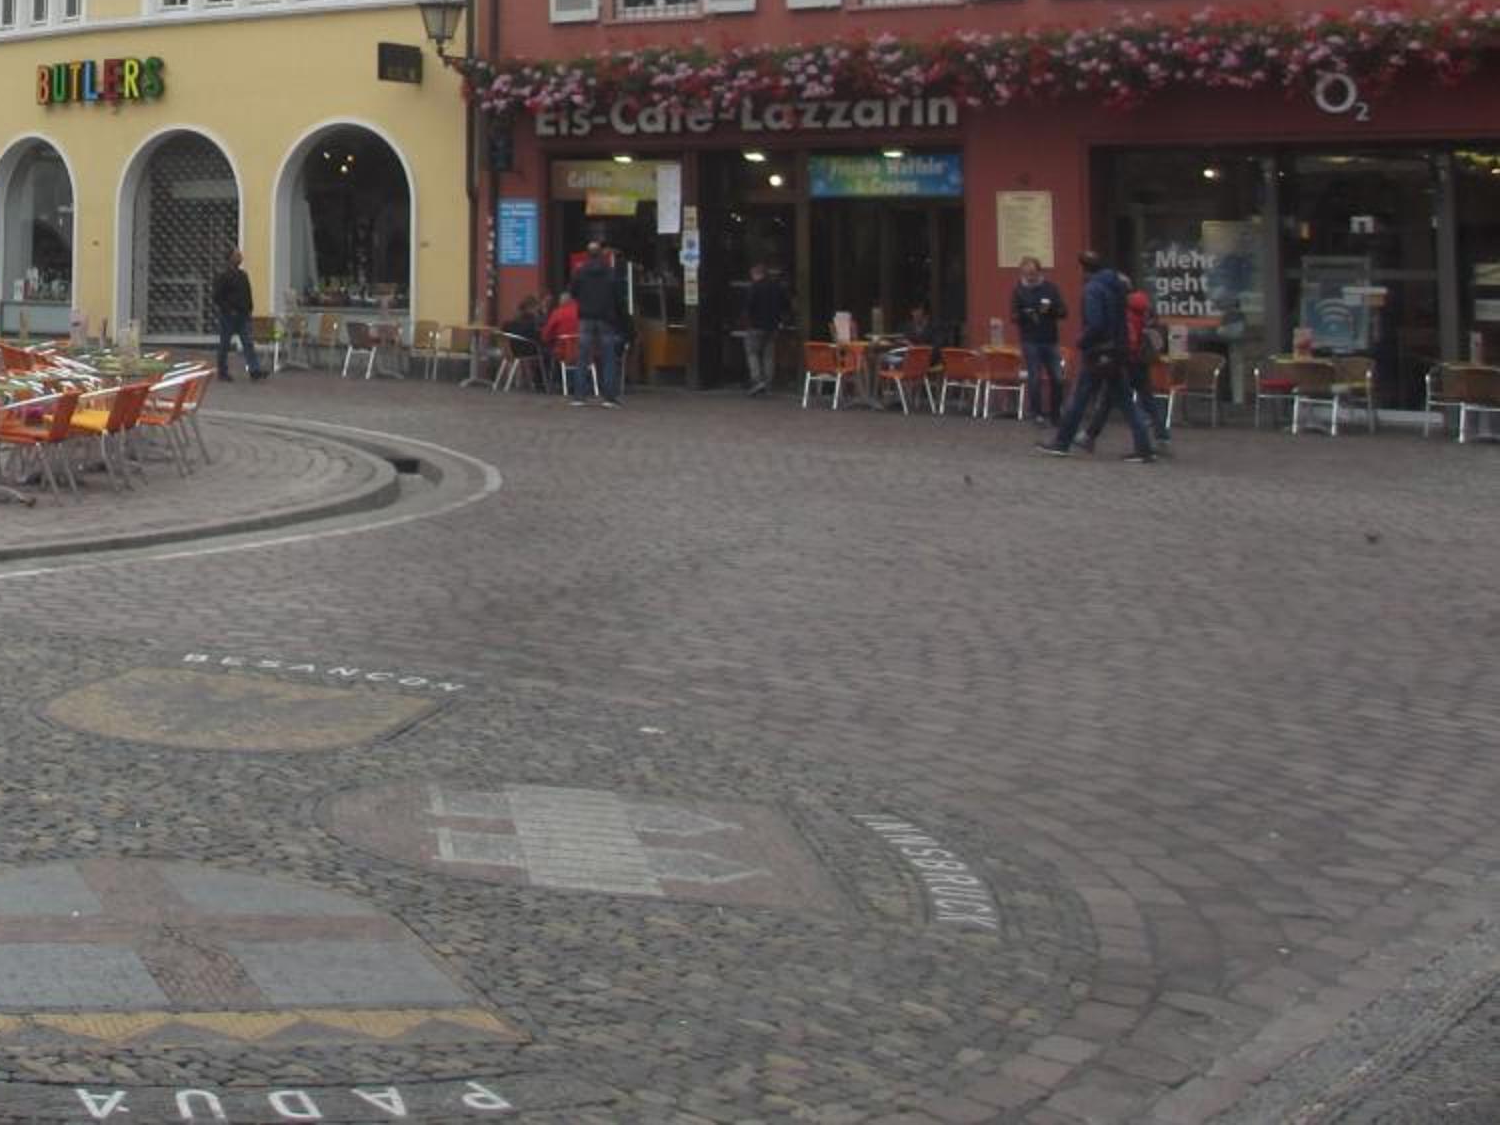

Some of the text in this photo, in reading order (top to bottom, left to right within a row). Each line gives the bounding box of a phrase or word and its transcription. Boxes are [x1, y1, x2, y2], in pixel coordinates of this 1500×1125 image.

[36, 56, 166, 107] BUTLERS
[1155, 249, 1217, 268] Mehr
[1155, 273, 1210, 296] geht
[851, 813, 997, 930] INNSBRUCK
[75, 1080, 513, 1121] PADUA
